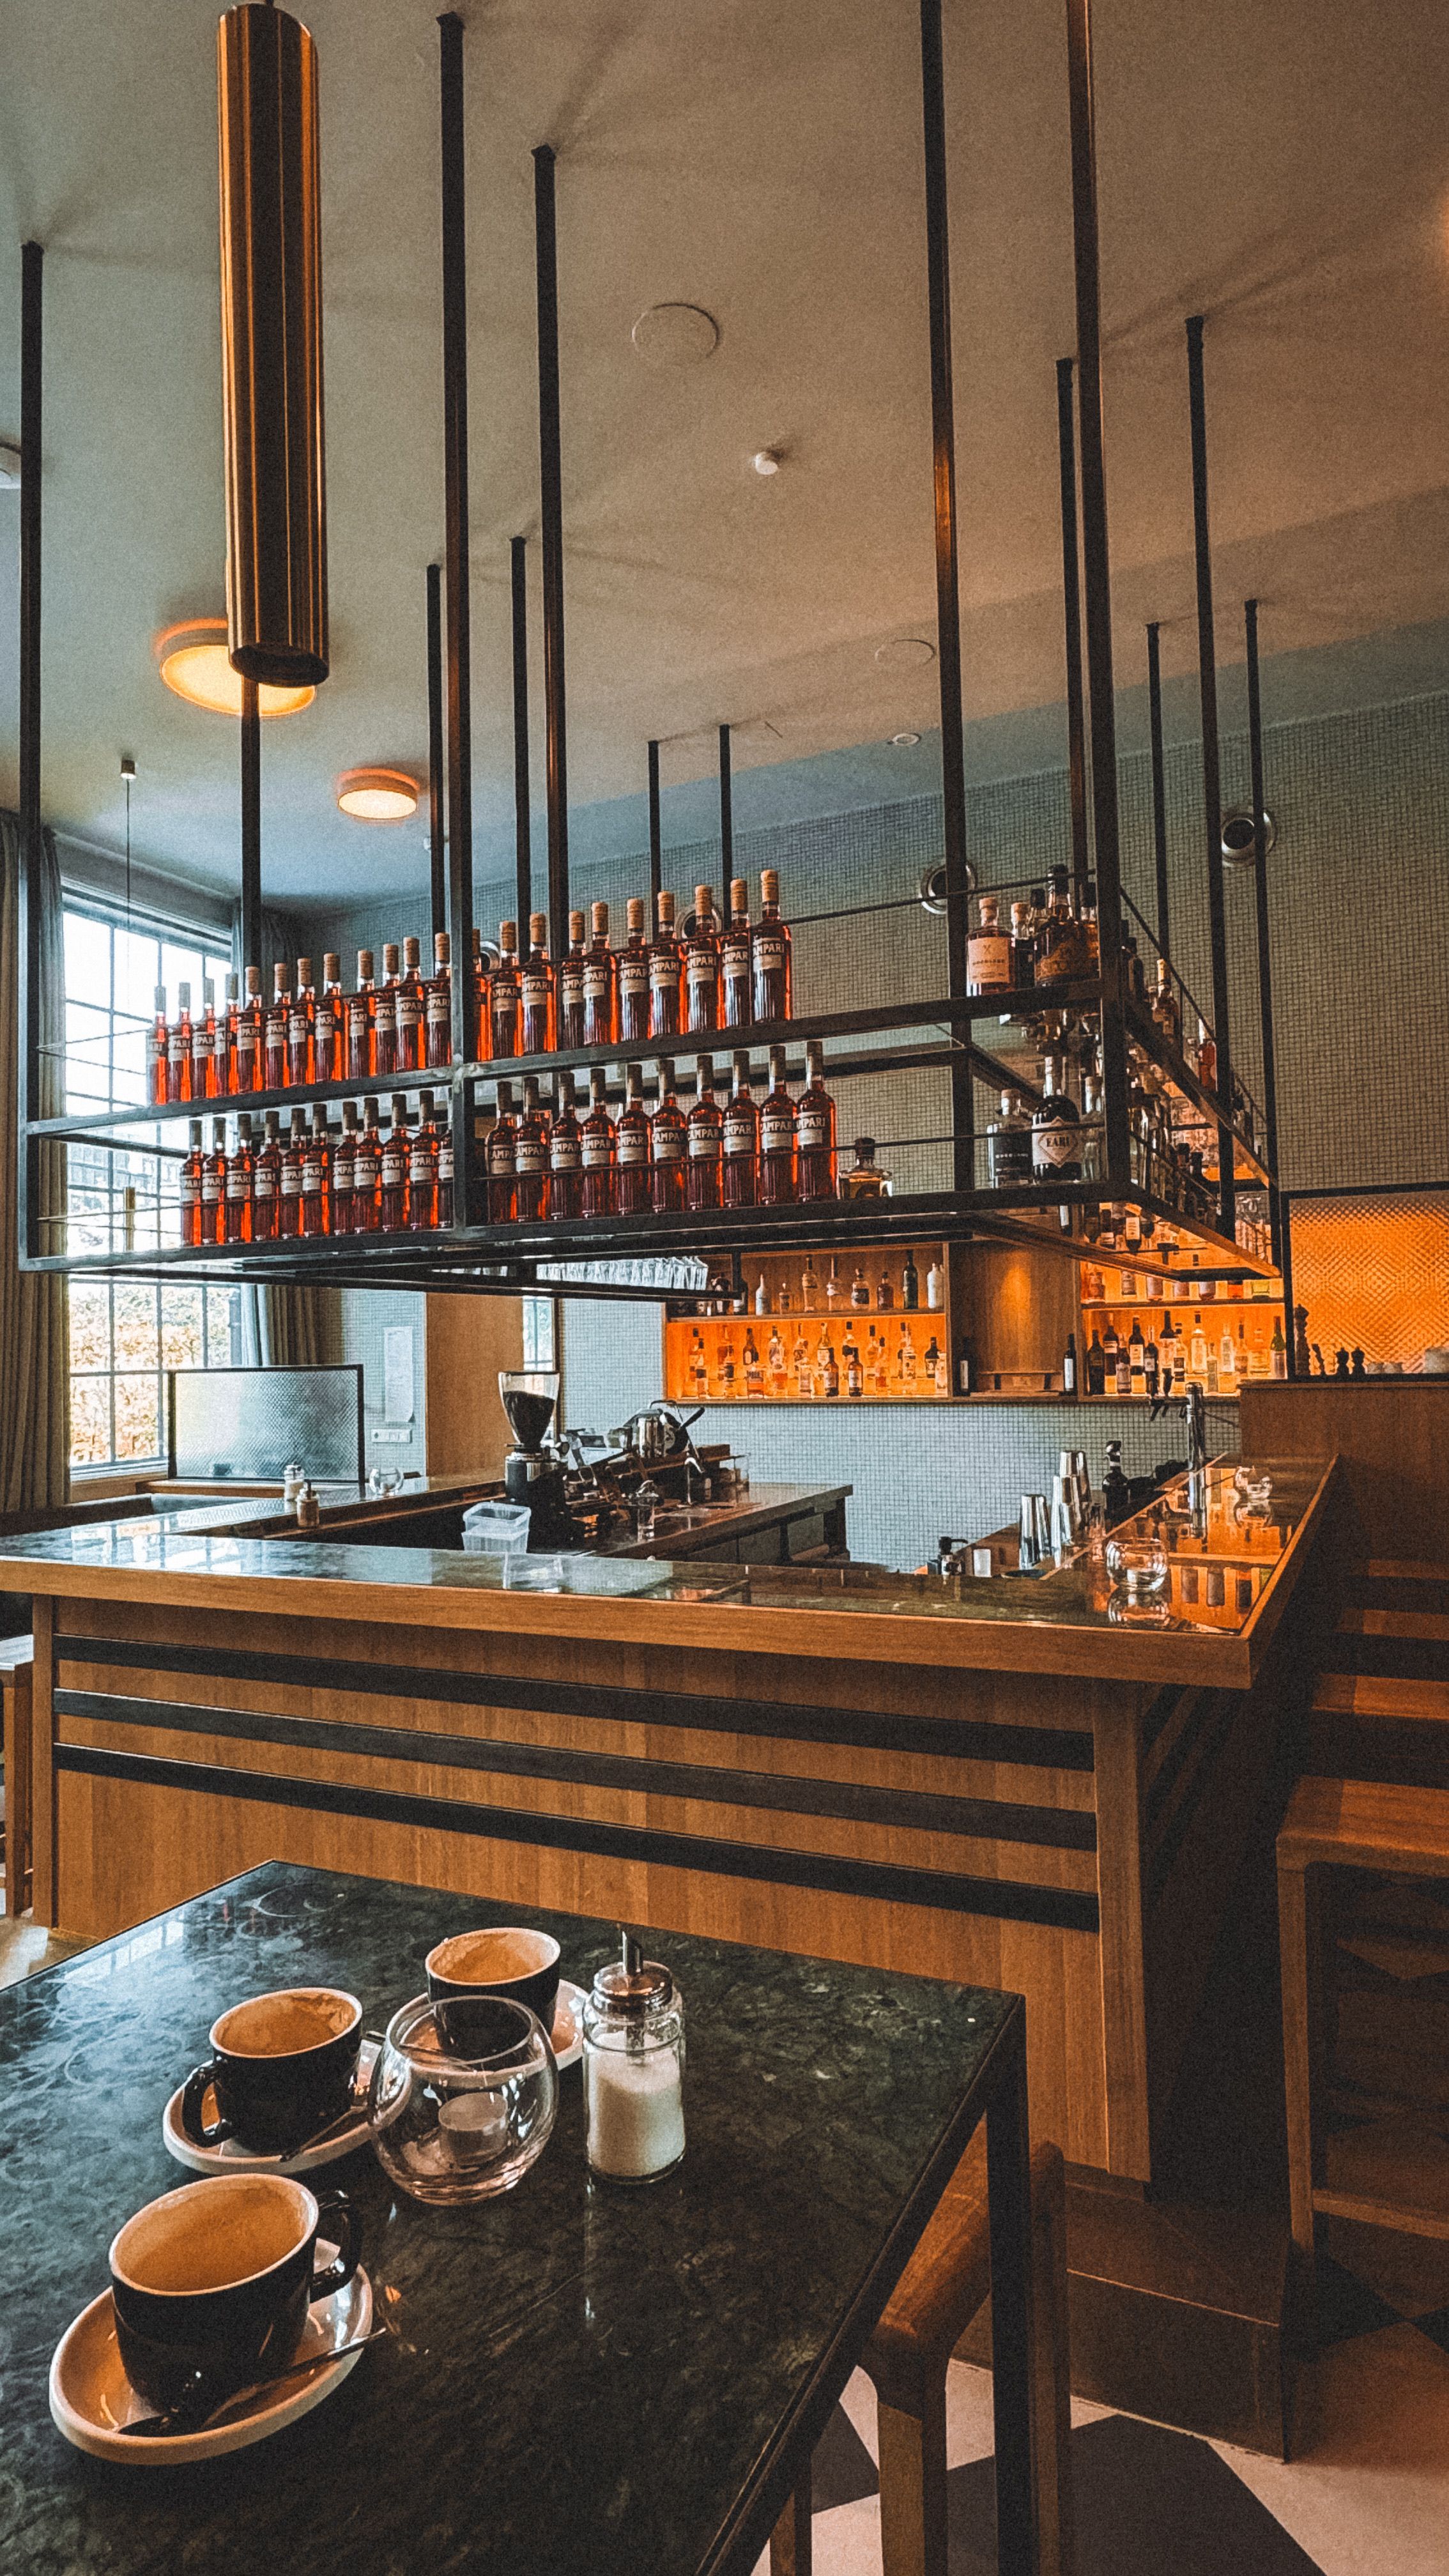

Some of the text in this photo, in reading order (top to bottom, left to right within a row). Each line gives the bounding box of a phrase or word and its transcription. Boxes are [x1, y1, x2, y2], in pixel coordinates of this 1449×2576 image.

[753, 942, 785, 957] AMPARI
[687, 954, 716, 969] AMPARI
[722, 950, 747, 965] AMPAR
[649, 960, 679, 975] AMPARI
[267, 1024, 286, 1035] PARI
